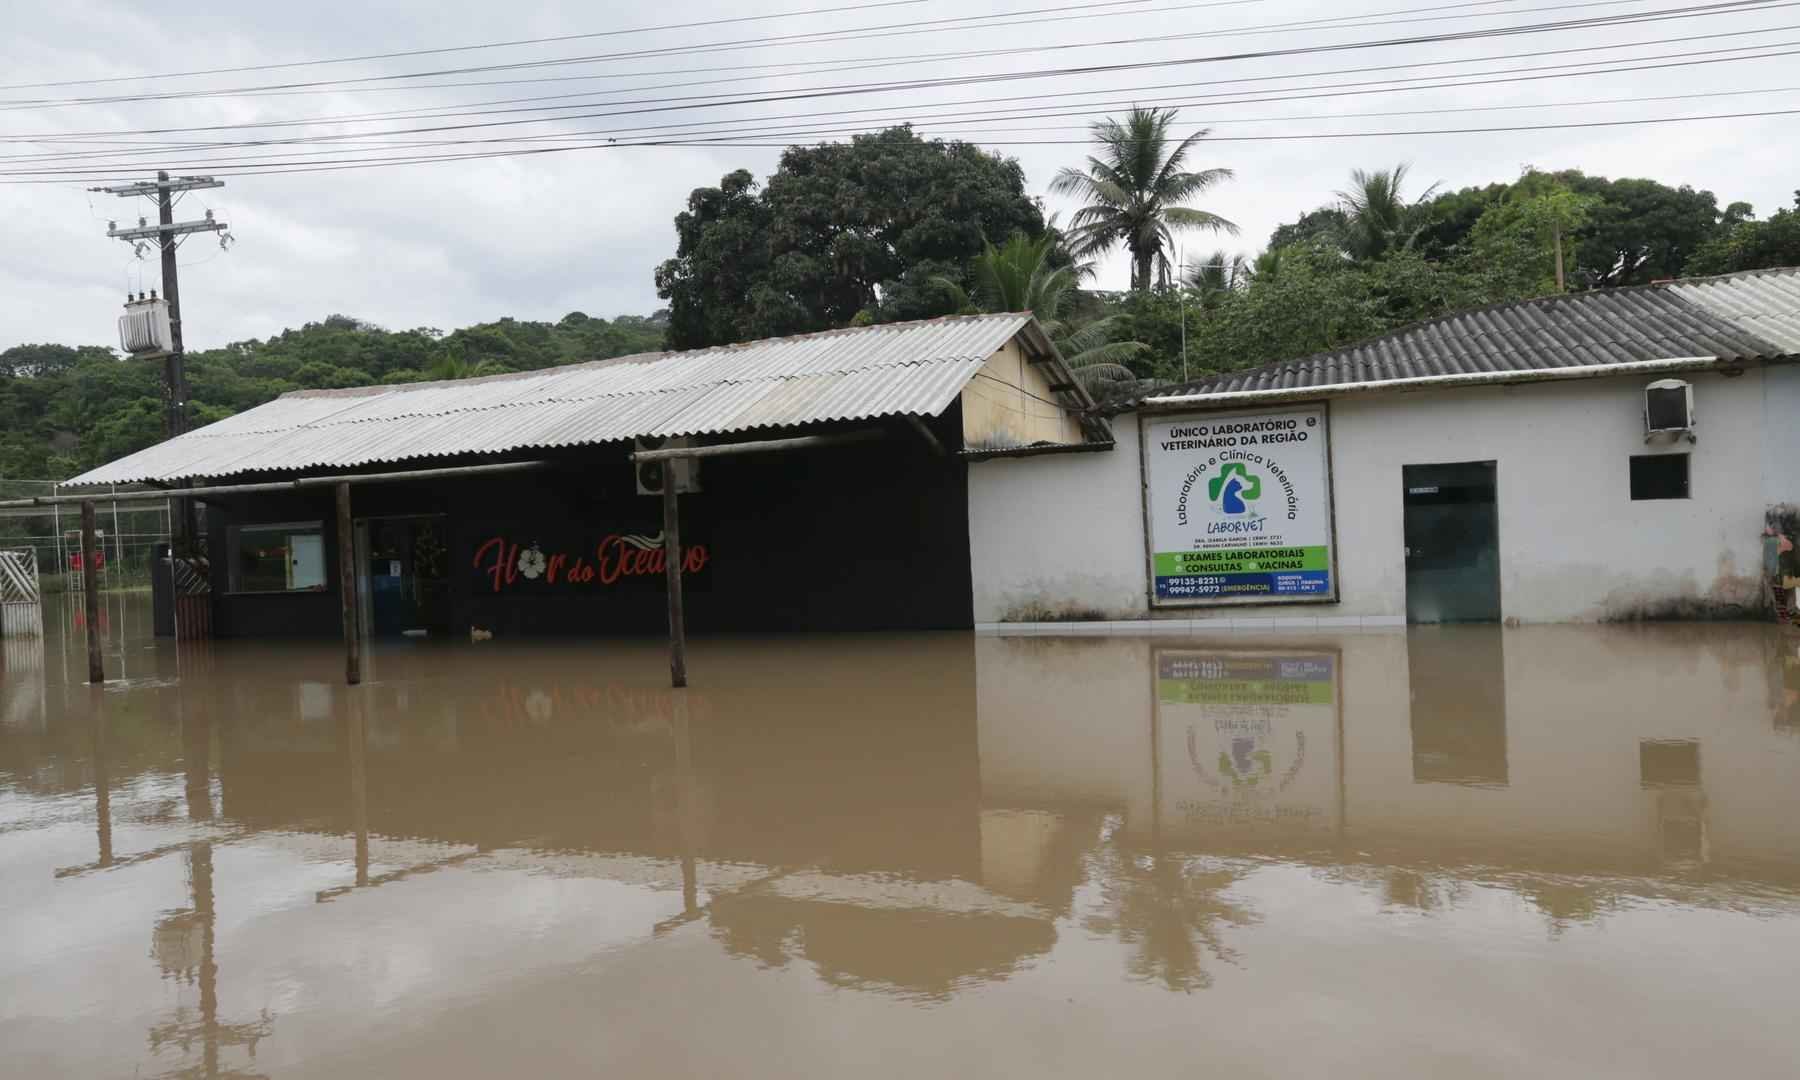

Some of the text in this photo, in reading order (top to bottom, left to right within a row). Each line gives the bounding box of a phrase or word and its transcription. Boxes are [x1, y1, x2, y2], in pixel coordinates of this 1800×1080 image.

[1170, 418, 1297, 438] ÚNICO LABORATÓRIO
[1161, 430, 1308, 452] VETERINÁRIO DA REGIÃO
[1175, 449, 1299, 526] Laboratório e Clínica Veterinária
[1207, 517, 1268, 535] LABORVET
[1183, 548, 1305, 562] EXAMES LABORATORIAIS
[567, 557, 596, 584] do
[1185, 562, 1243, 573] CONSULTAS
[1257, 560, 1304, 571] VACINAS
